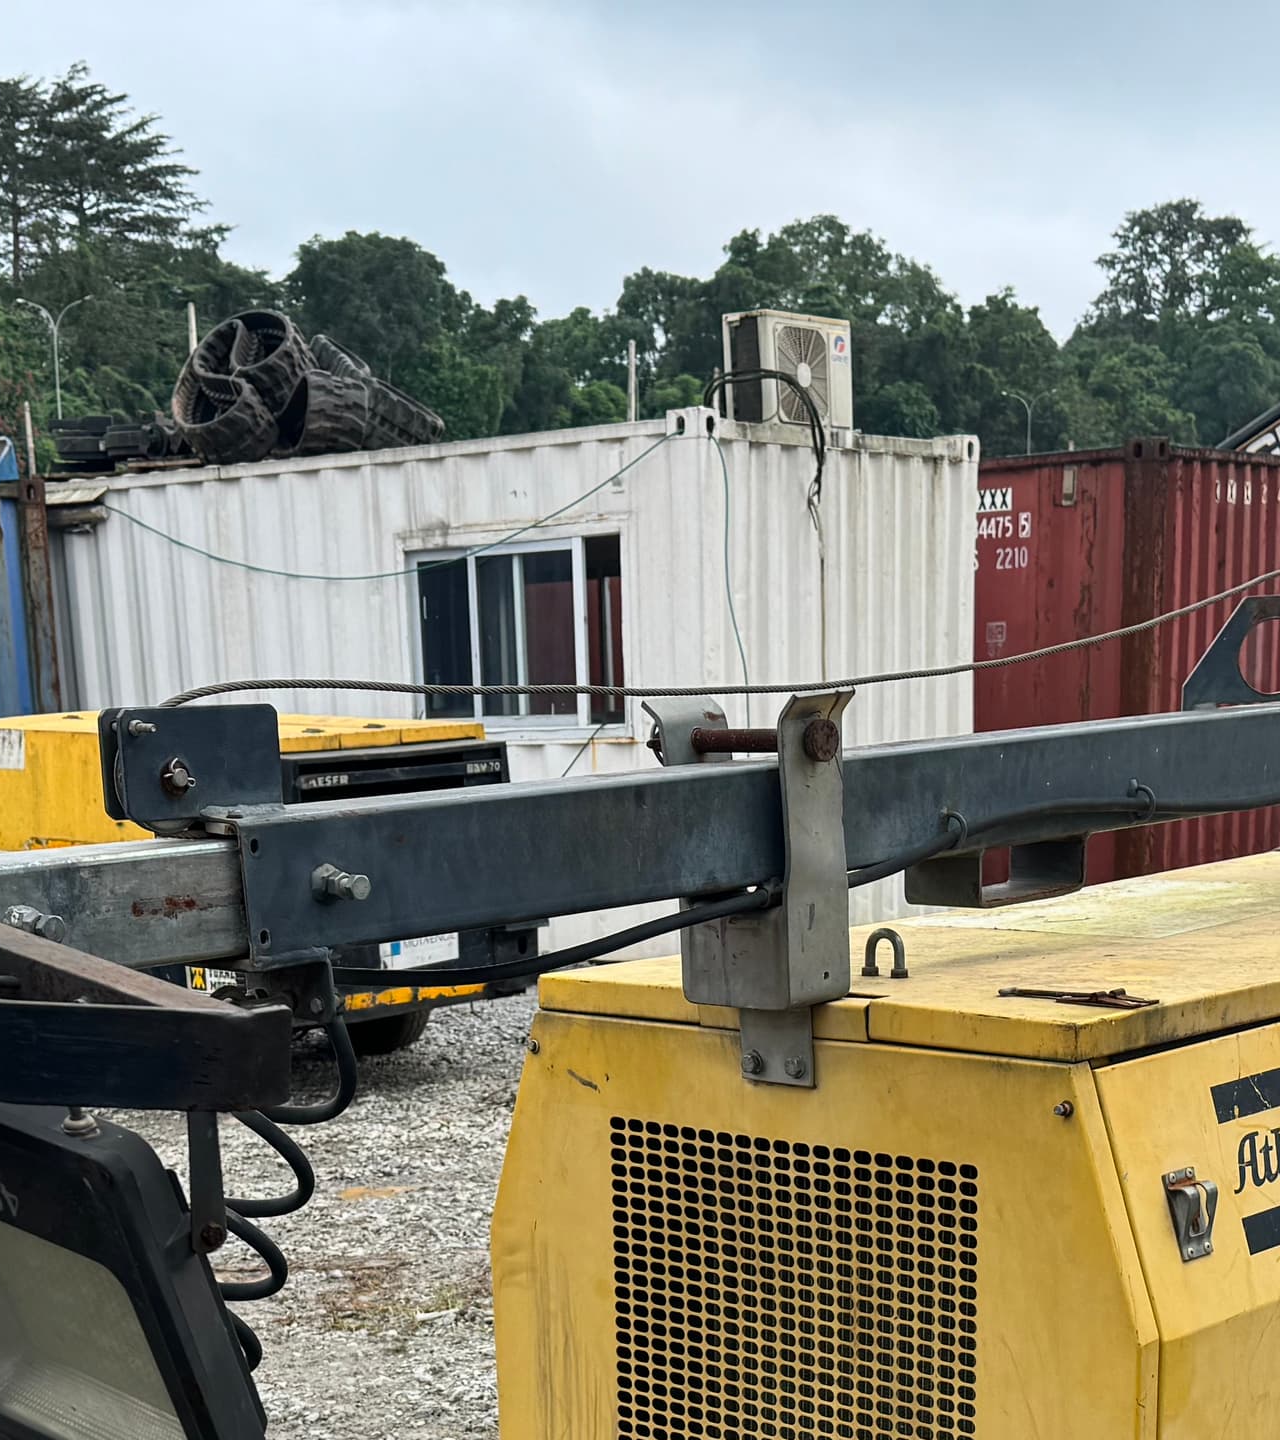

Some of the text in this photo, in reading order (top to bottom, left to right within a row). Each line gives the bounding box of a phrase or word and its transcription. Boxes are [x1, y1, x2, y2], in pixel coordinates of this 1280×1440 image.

[976, 512, 1031, 539] 4475 5
[996, 546, 1029, 570] 2210
